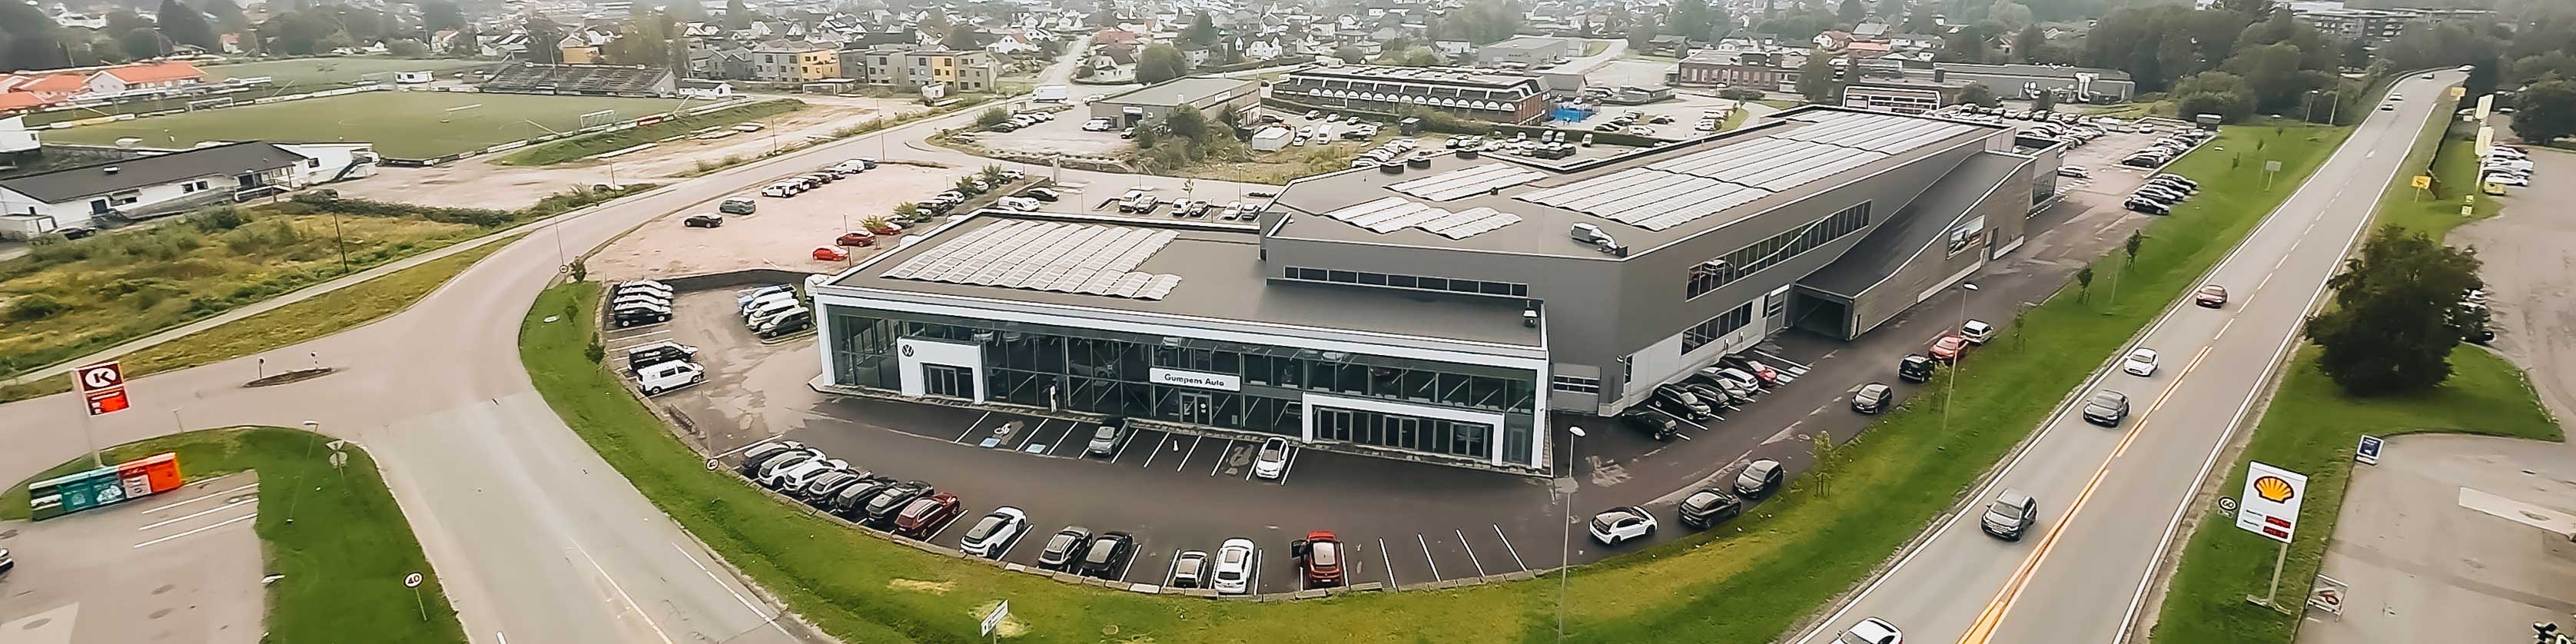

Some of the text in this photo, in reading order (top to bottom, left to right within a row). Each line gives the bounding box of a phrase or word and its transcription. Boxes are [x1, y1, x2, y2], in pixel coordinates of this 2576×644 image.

[1164, 373, 1224, 387] Gumpens Auto
[407, 575, 420, 584] 40
